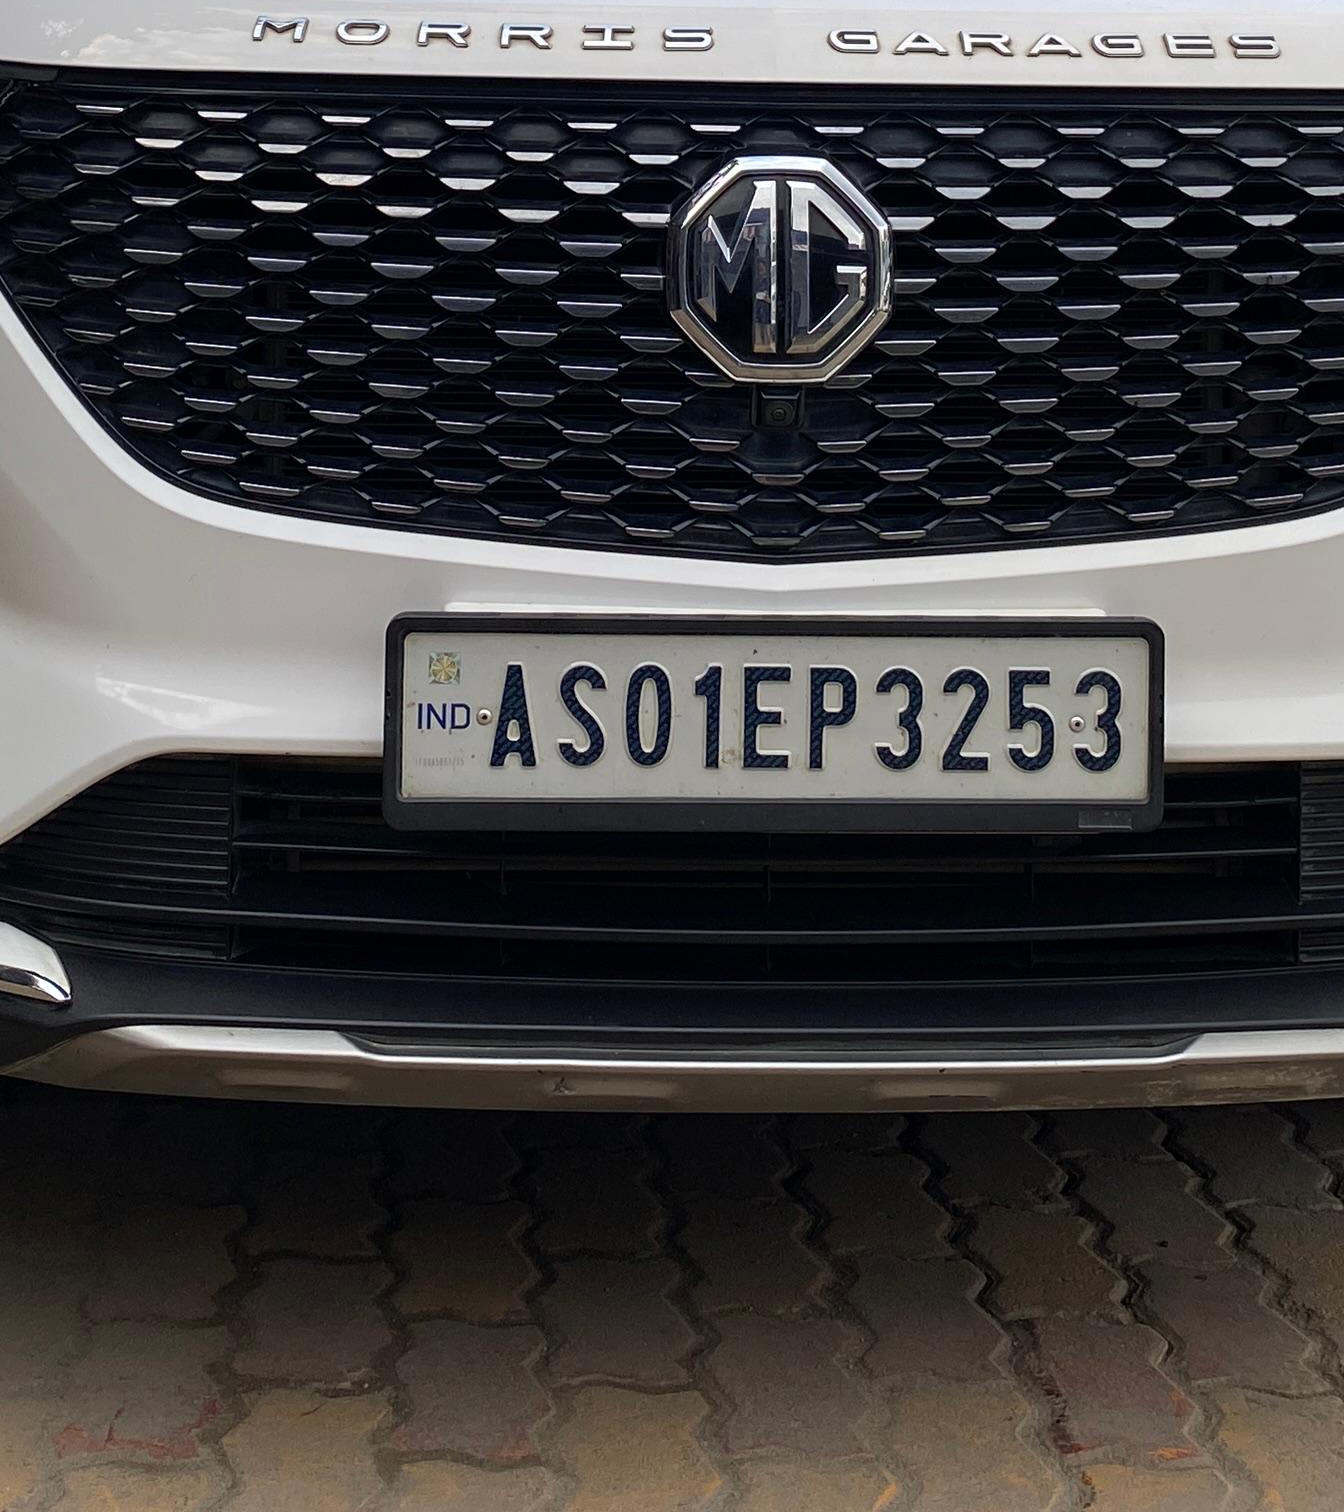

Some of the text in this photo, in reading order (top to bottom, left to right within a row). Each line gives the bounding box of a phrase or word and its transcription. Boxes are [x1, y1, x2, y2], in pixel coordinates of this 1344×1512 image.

[252, 15, 1281, 58] MORRIS GARAGES
[697, 180, 867, 354] MG
[417, 703, 471, 729] IND
[490, 663, 1123, 773] AS01EP3253
